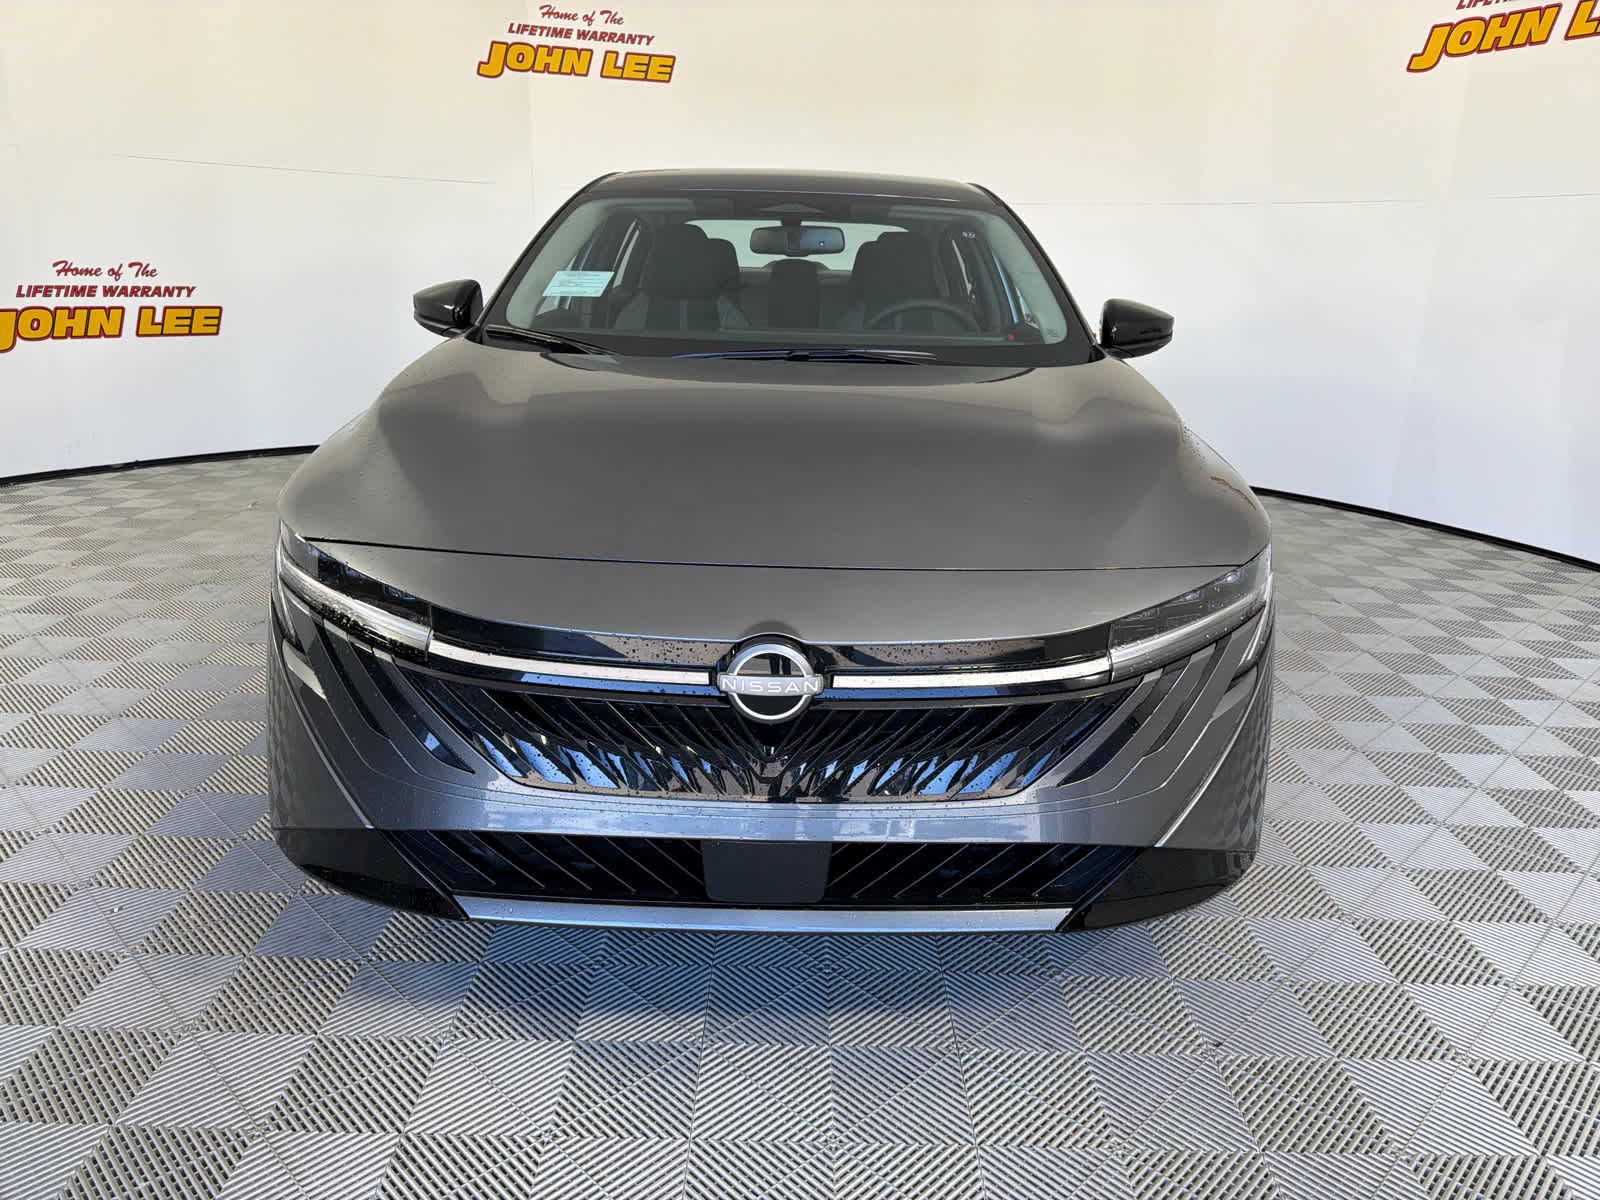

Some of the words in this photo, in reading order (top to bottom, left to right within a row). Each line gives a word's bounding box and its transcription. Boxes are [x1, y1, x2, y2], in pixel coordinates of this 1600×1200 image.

[538, 4, 578, 21] Home
[582, 11, 595, 26] of
[599, 10, 624, 25] The
[508, 23, 573, 39] LIFETIME
[576, 30, 655, 46] WARRANTY
[1406, 3, 1563, 73] JOHN
[477, 40, 593, 78] JOHN
[600, 50, 676, 83] LEE
[52, 260, 102, 278] Home
[107, 264, 123, 281] of
[128, 261, 158, 277] The
[16, 285, 97, 298] LIFETIME
[102, 285, 196, 298] WARRANTY
[136, 306, 223, 337] LEE
[721, 678, 819, 693] NISSAN
